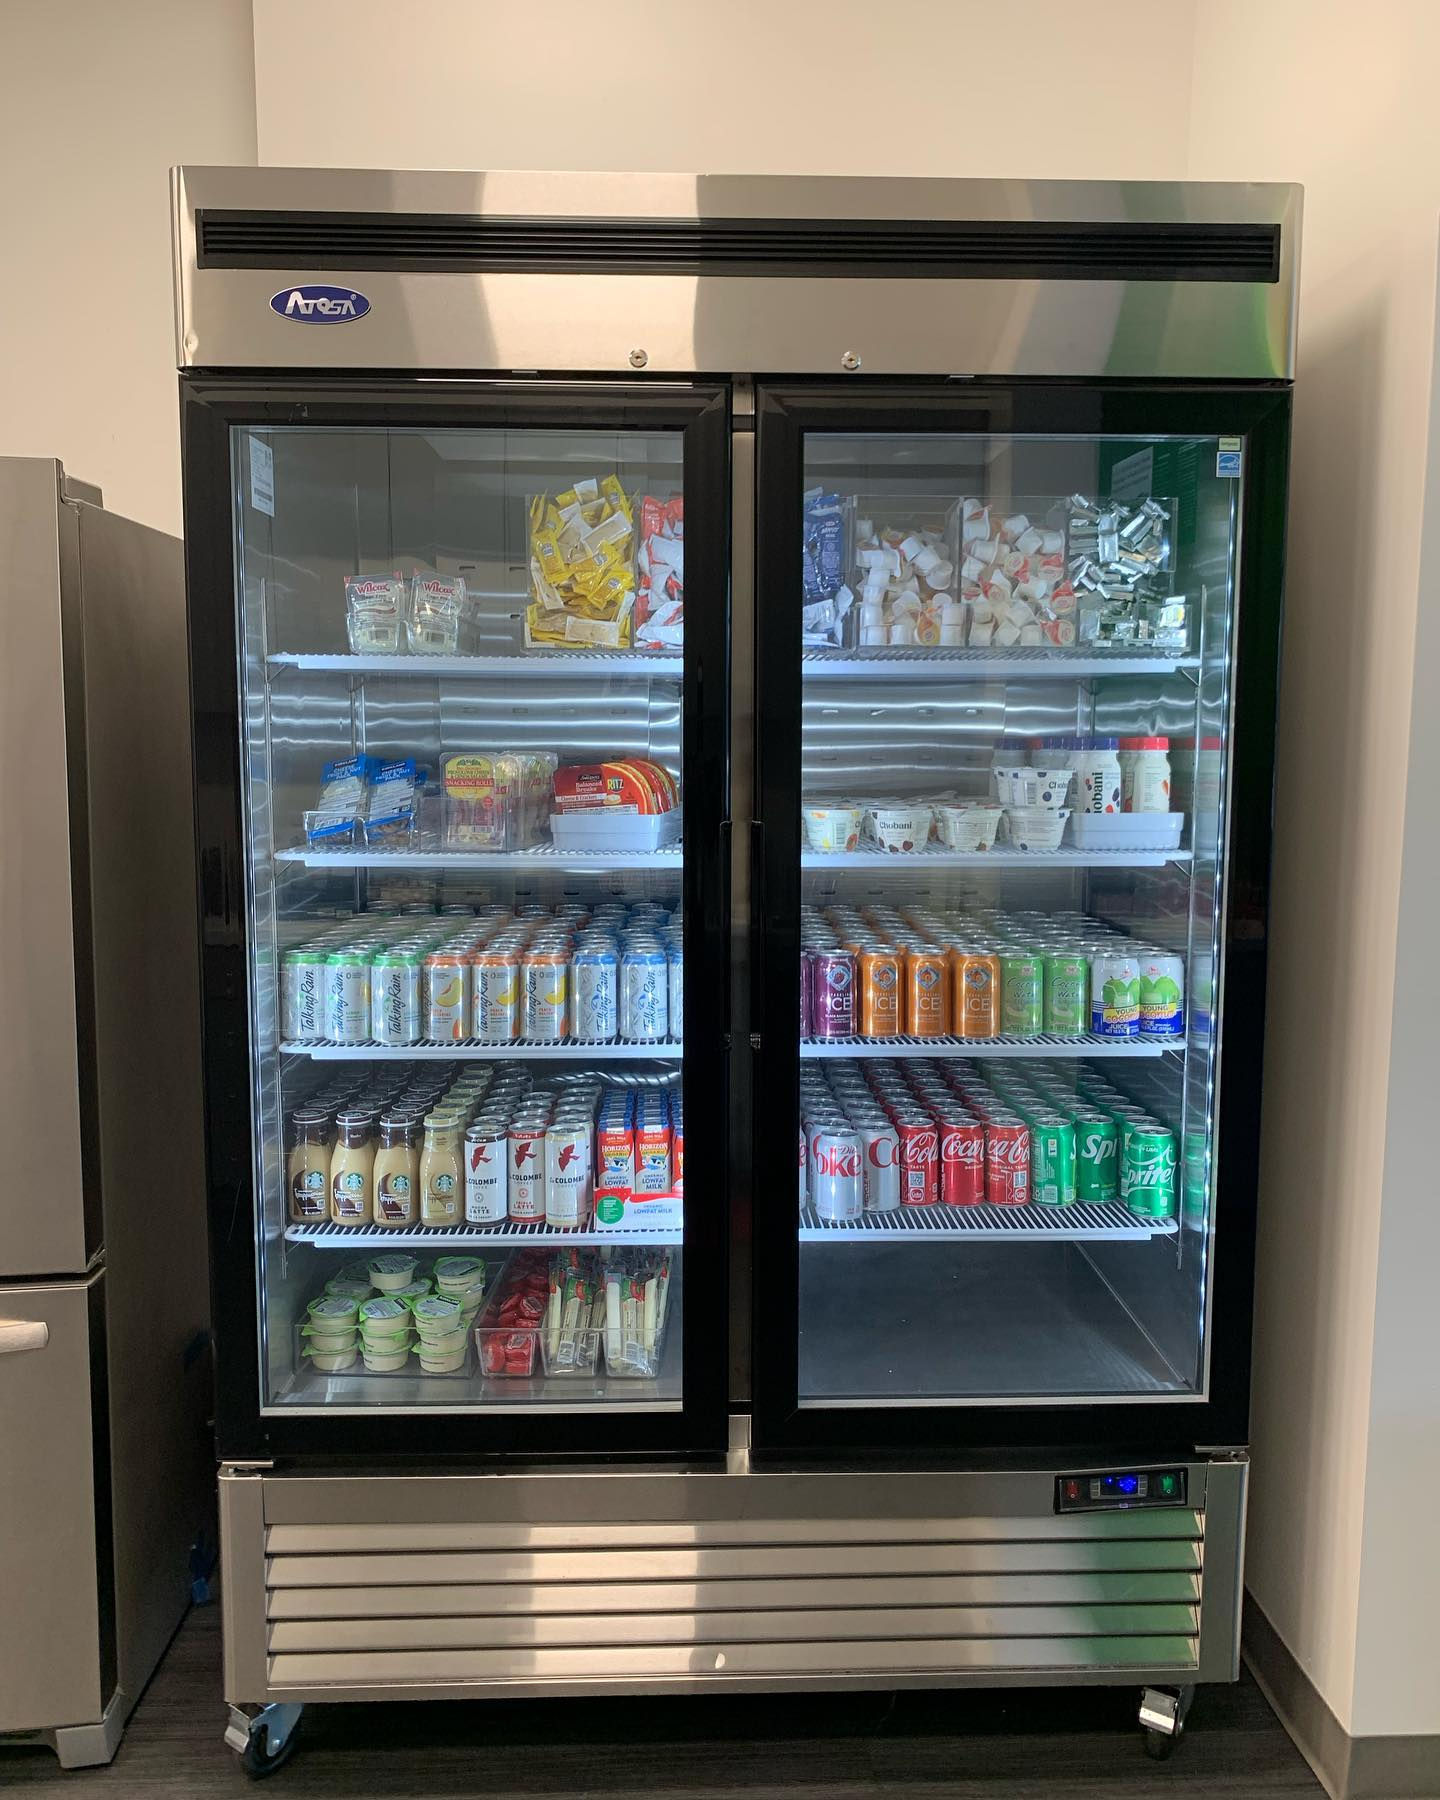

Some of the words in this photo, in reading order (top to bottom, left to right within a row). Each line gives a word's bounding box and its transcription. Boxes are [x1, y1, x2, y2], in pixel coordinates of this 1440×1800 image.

[356, 582, 390, 595] Wilcox
[422, 581, 456, 597] Wilcox
[607, 778, 624, 790] RITZ
[1092, 772, 1104, 813] obani
[879, 821, 913, 830] Chobani
[829, 997, 852, 1011] ICE
[874, 996, 897, 1010] ICE
[918, 997, 940, 1011] ICE
[966, 998, 991, 1011] ICE
[601, 1143, 631, 1152] HORIZON
[639, 1142, 668, 1151] HORIZON
[1081, 1134, 1118, 1165] Spr
[816, 1147, 862, 1178] oke
[512, 1173, 542, 1181] COLOMBE
[555, 1174, 585, 1184] COLOMBE
[1128, 1164, 1173, 1185] prite
